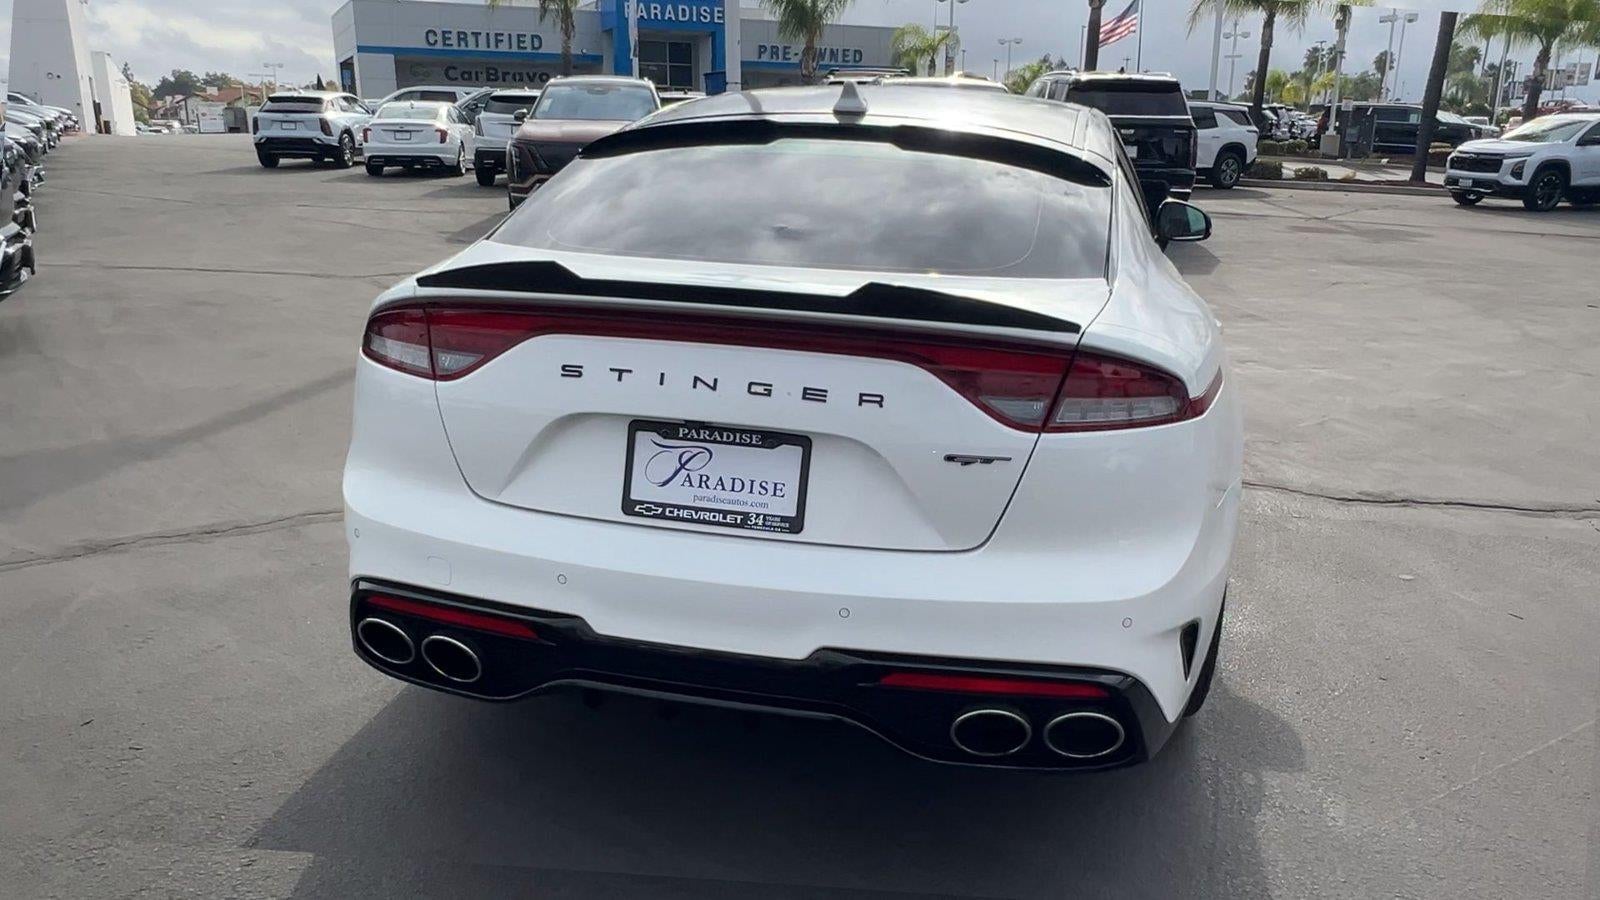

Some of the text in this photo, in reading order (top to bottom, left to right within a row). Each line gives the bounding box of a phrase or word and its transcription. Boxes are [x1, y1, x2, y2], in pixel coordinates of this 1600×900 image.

[425, 29, 543, 51] CERTIFIED
[757, 44, 863, 64] PRE-WNED
[444, 66, 550, 82] CarBravo
[560, 364, 885, 408] STINGER
[678, 427, 762, 445] PARADISE
[645, 438, 786, 498] PARADISE
[692, 494, 769, 509] paradiseautos.com
[665, 507, 764, 526] CHEVROLET 34
